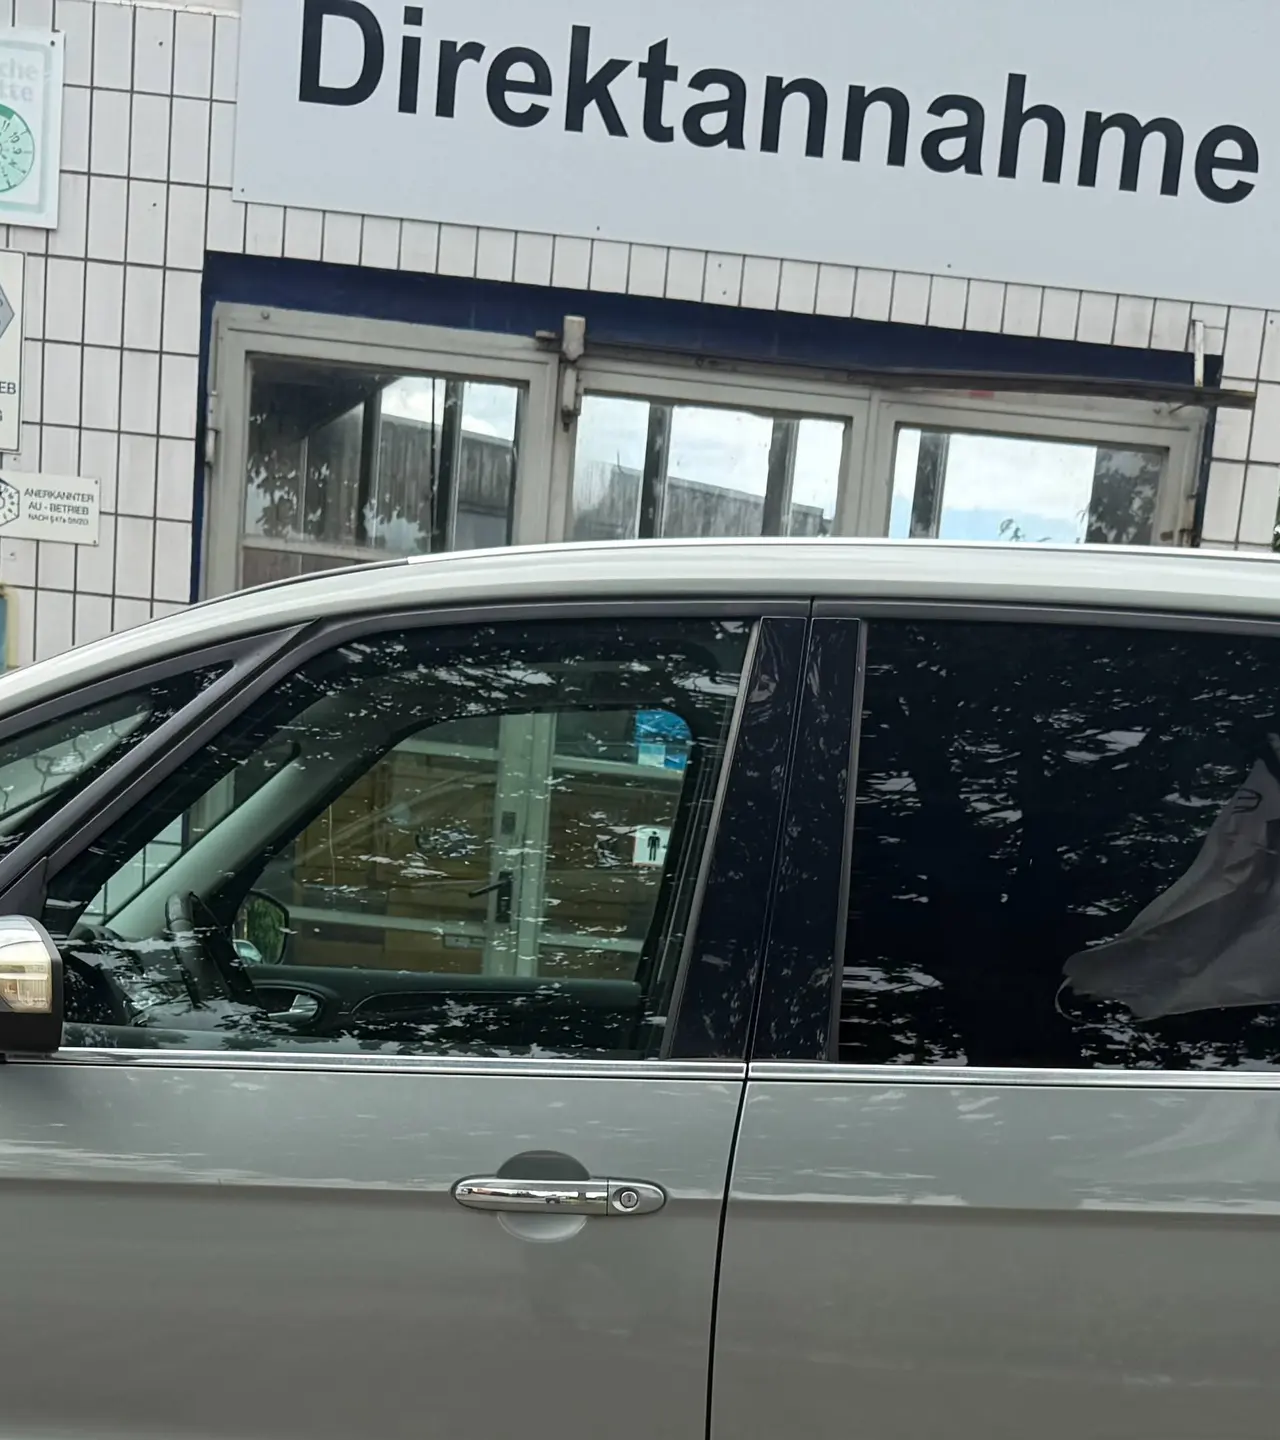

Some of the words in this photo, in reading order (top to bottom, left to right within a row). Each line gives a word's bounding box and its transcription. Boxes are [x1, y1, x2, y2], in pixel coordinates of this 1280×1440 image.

[297, 0, 1261, 204] Direktannahme
[24, 487, 95, 504] ANERKANNTER
[50, 504, 90, 515] BETRIEB
